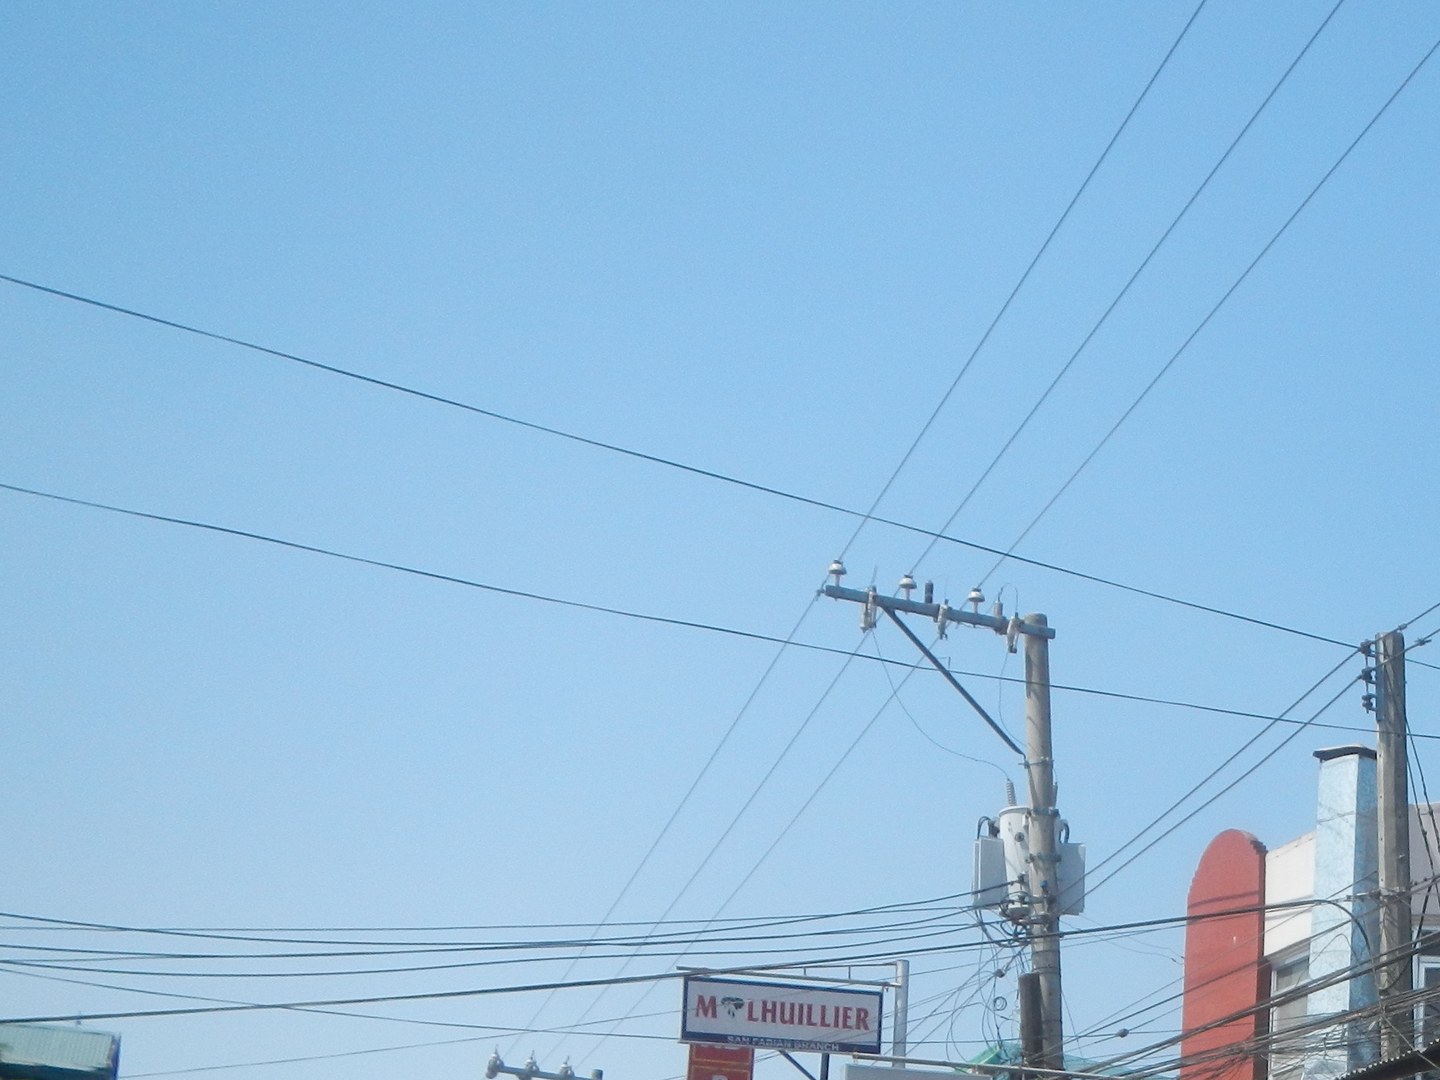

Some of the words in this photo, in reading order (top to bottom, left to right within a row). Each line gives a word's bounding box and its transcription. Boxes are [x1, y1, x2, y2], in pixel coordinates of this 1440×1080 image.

[747, 998, 870, 1031] LHUILLIER
[727, 1035, 750, 1045] SAN
[752, 1037, 792, 1049] FABIAN
[793, 1041, 840, 1051] BRANCH
